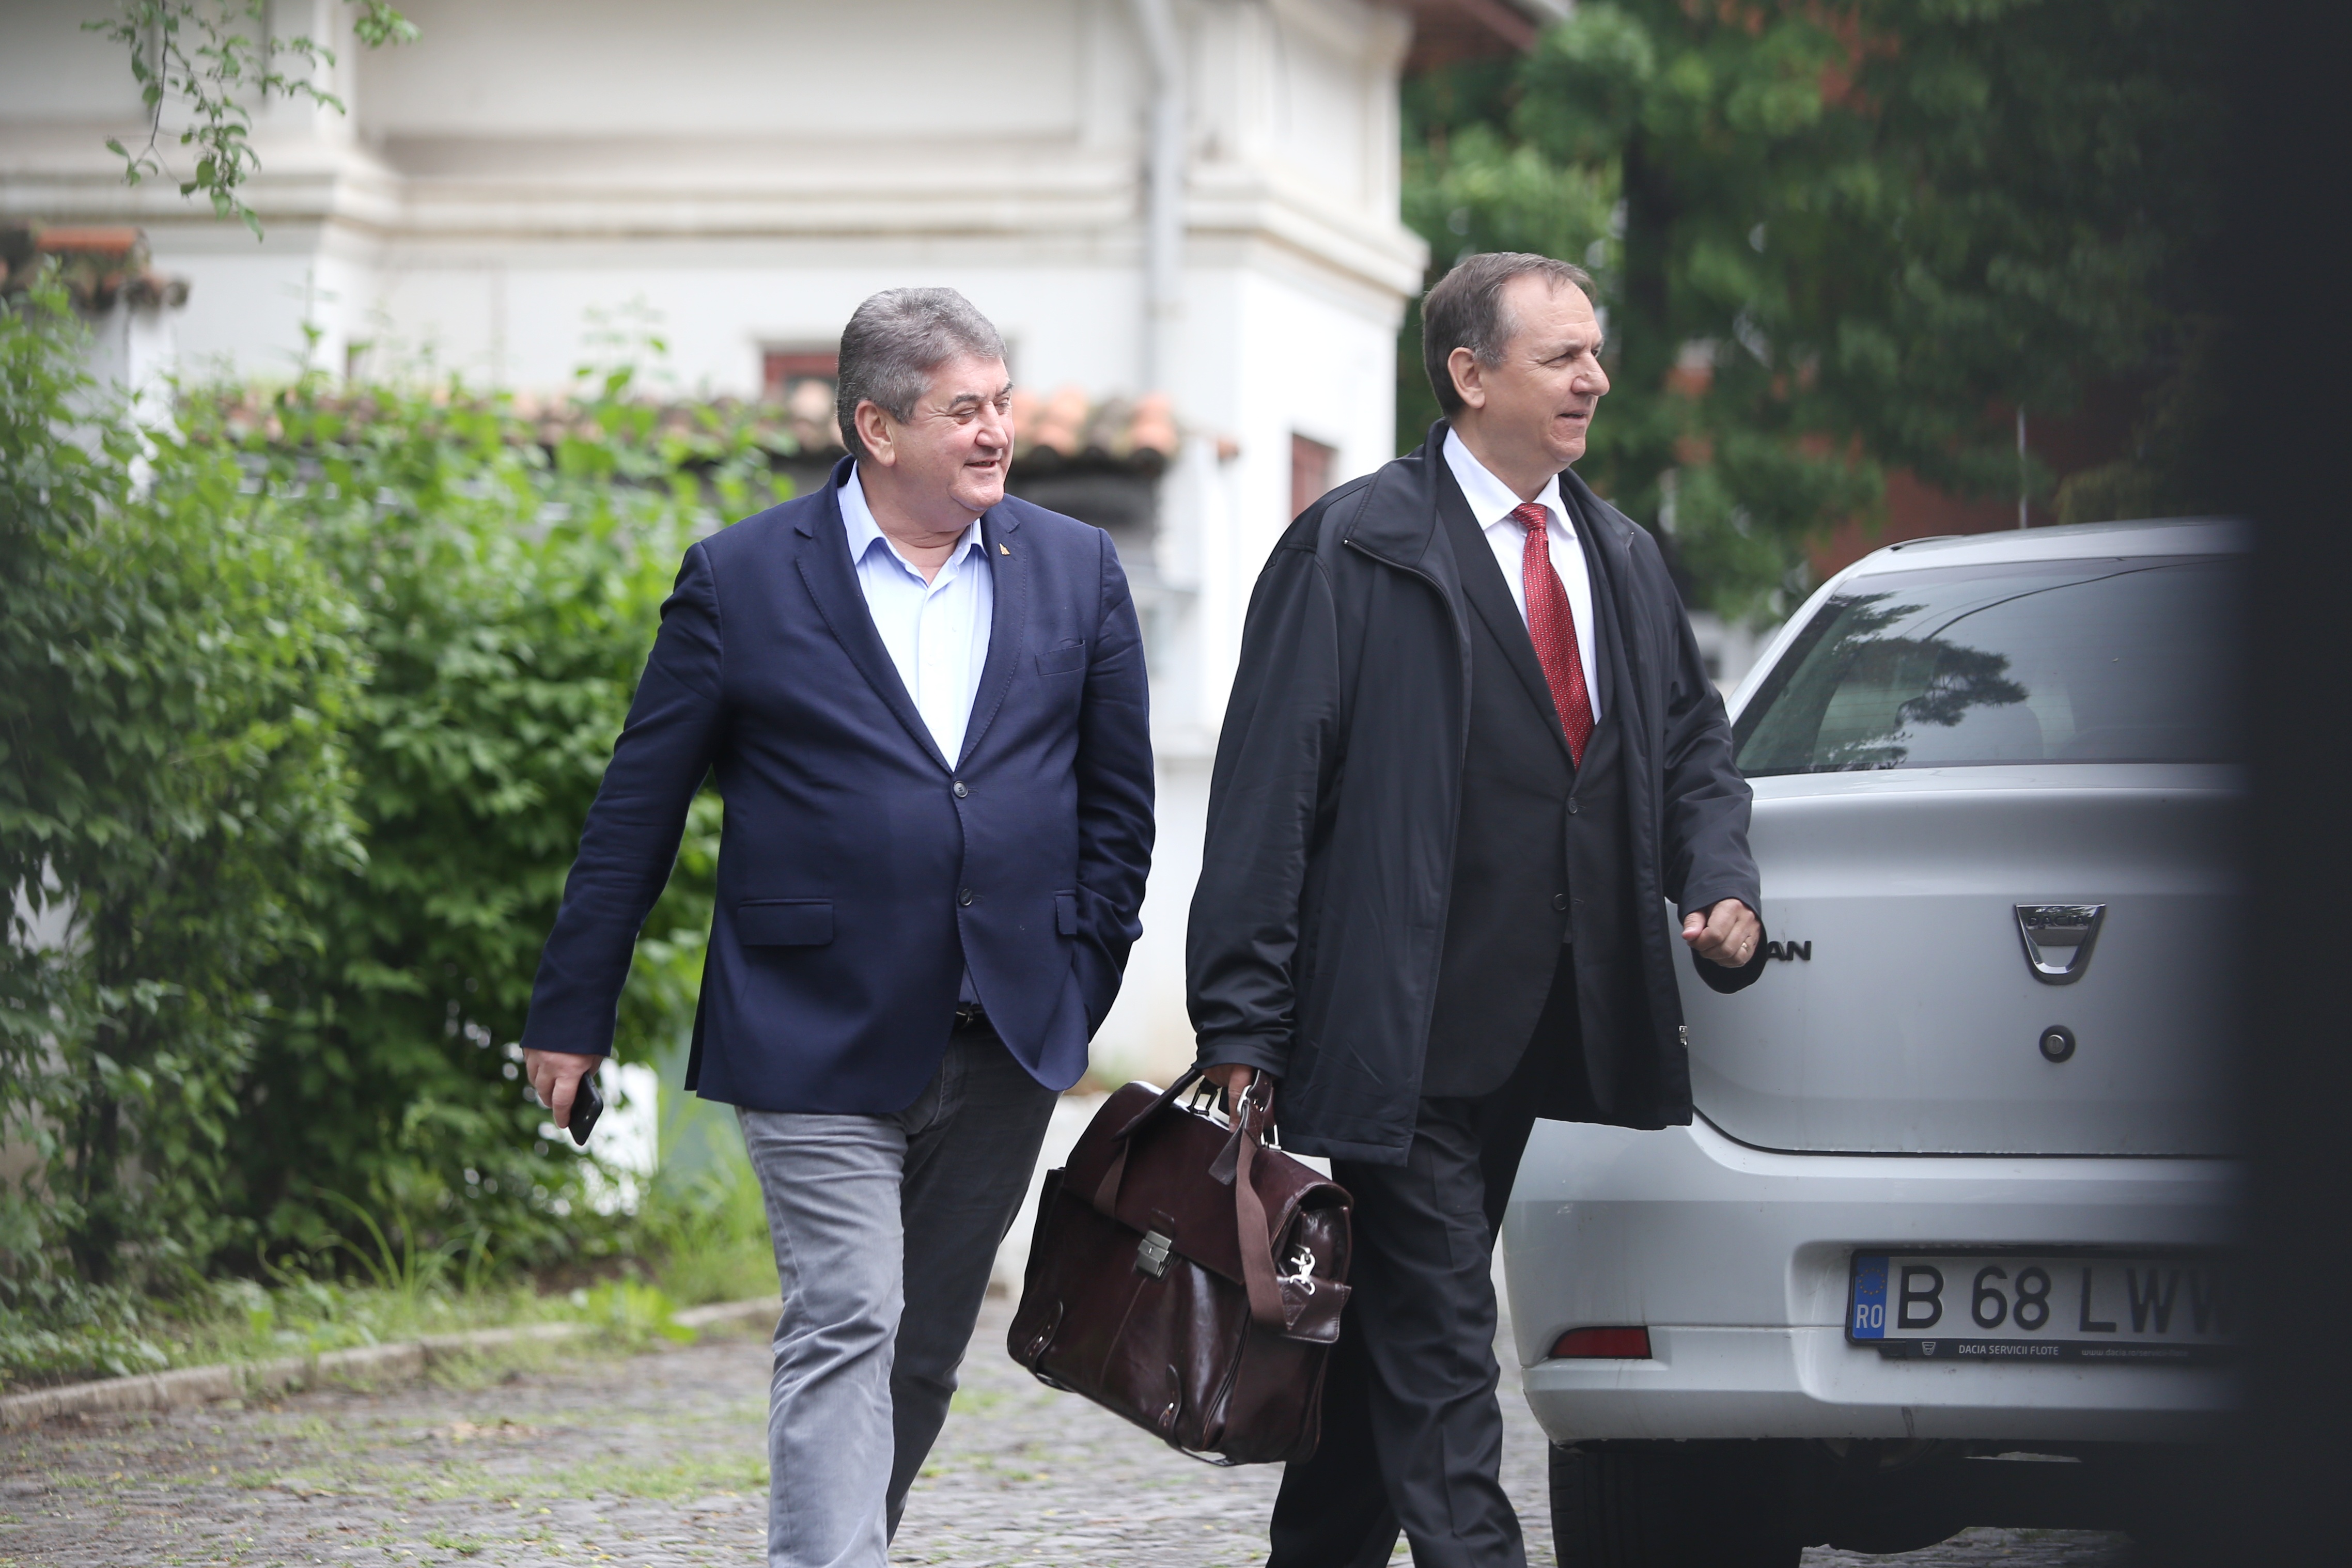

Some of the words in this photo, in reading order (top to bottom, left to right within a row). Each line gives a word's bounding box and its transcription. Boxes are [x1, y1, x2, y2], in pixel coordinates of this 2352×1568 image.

[2028, 916, 2087, 926] DACIA
[1897, 1265, 1944, 1329] B
[1971, 1266, 2051, 1331] 68
[1856, 1304, 1883, 1328] RO
[1959, 1345, 1986, 1354] DACIA
[1989, 1345, 2027, 1354] SERVICII
[2030, 1346, 2059, 1355] FLOTE
